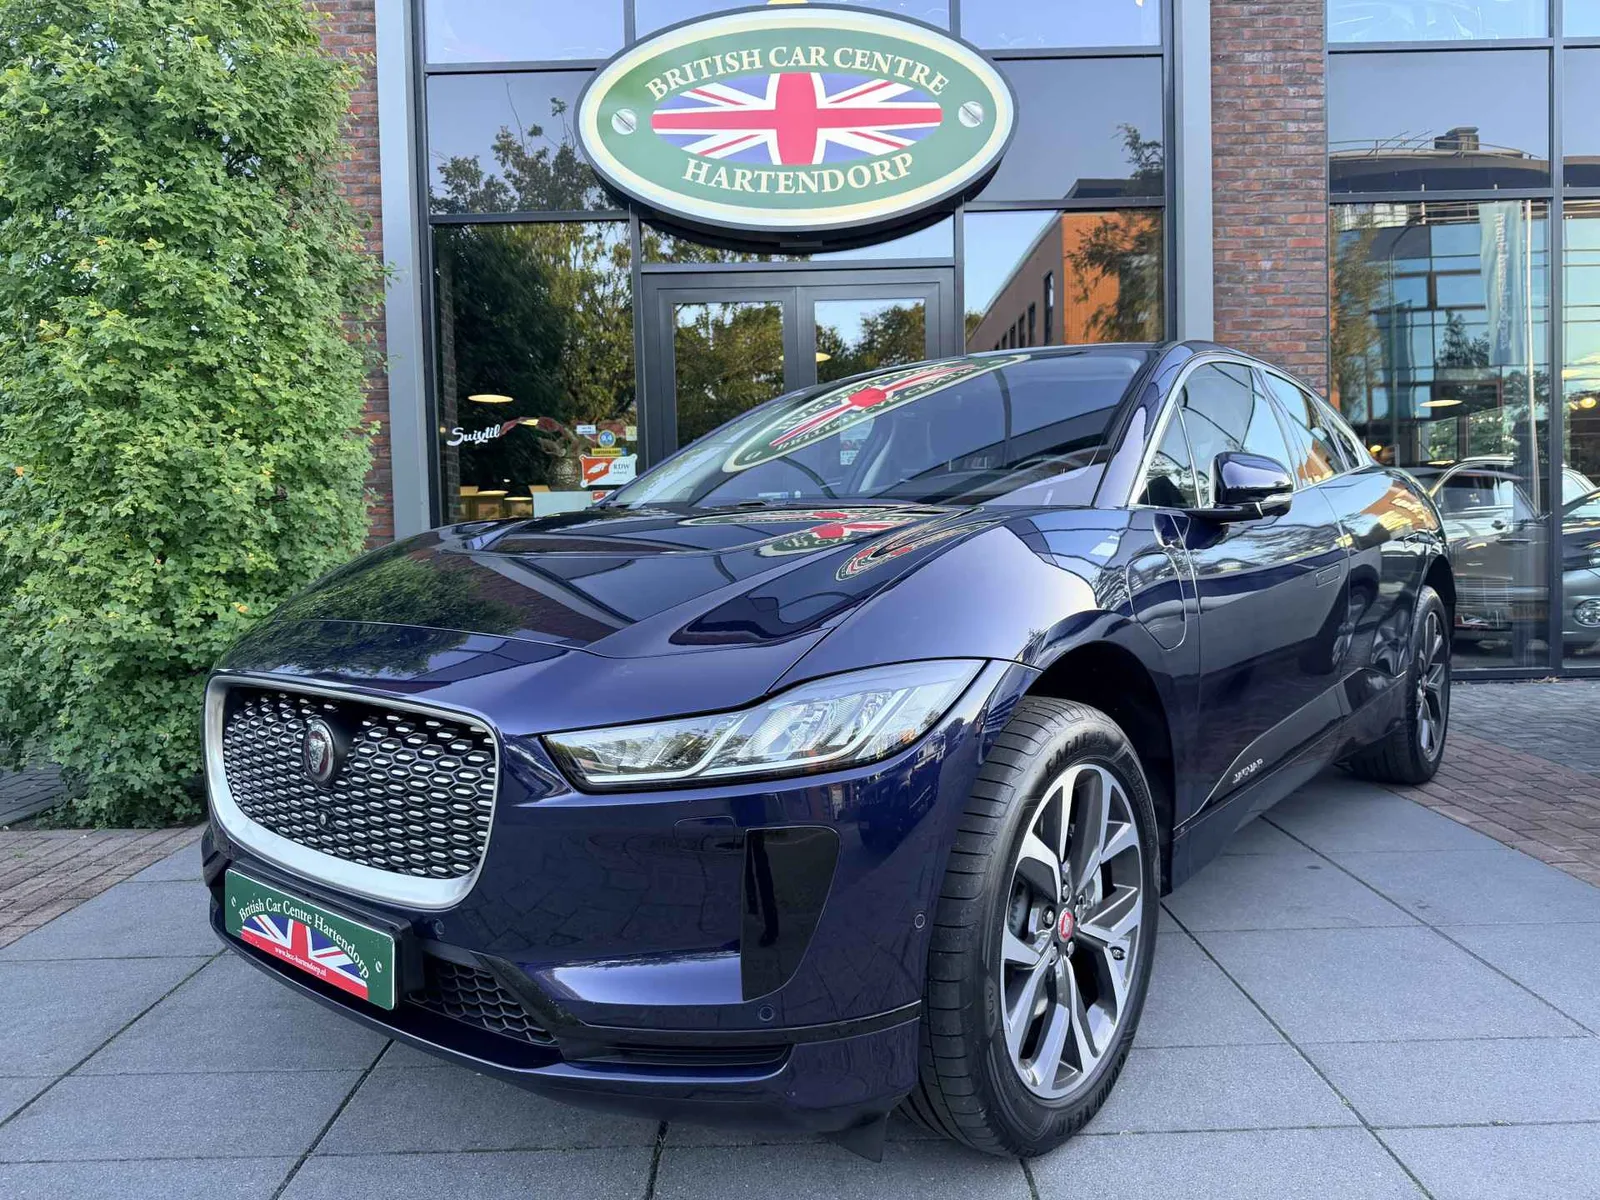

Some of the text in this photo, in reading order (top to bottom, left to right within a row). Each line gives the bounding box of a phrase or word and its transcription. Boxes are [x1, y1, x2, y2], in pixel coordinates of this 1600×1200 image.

[645, 46, 949, 101] BRITISH CAR CENTRE
[681, 152, 913, 194] HARTENDORP
[239, 898, 369, 979] British Car Centre Hartendorp
